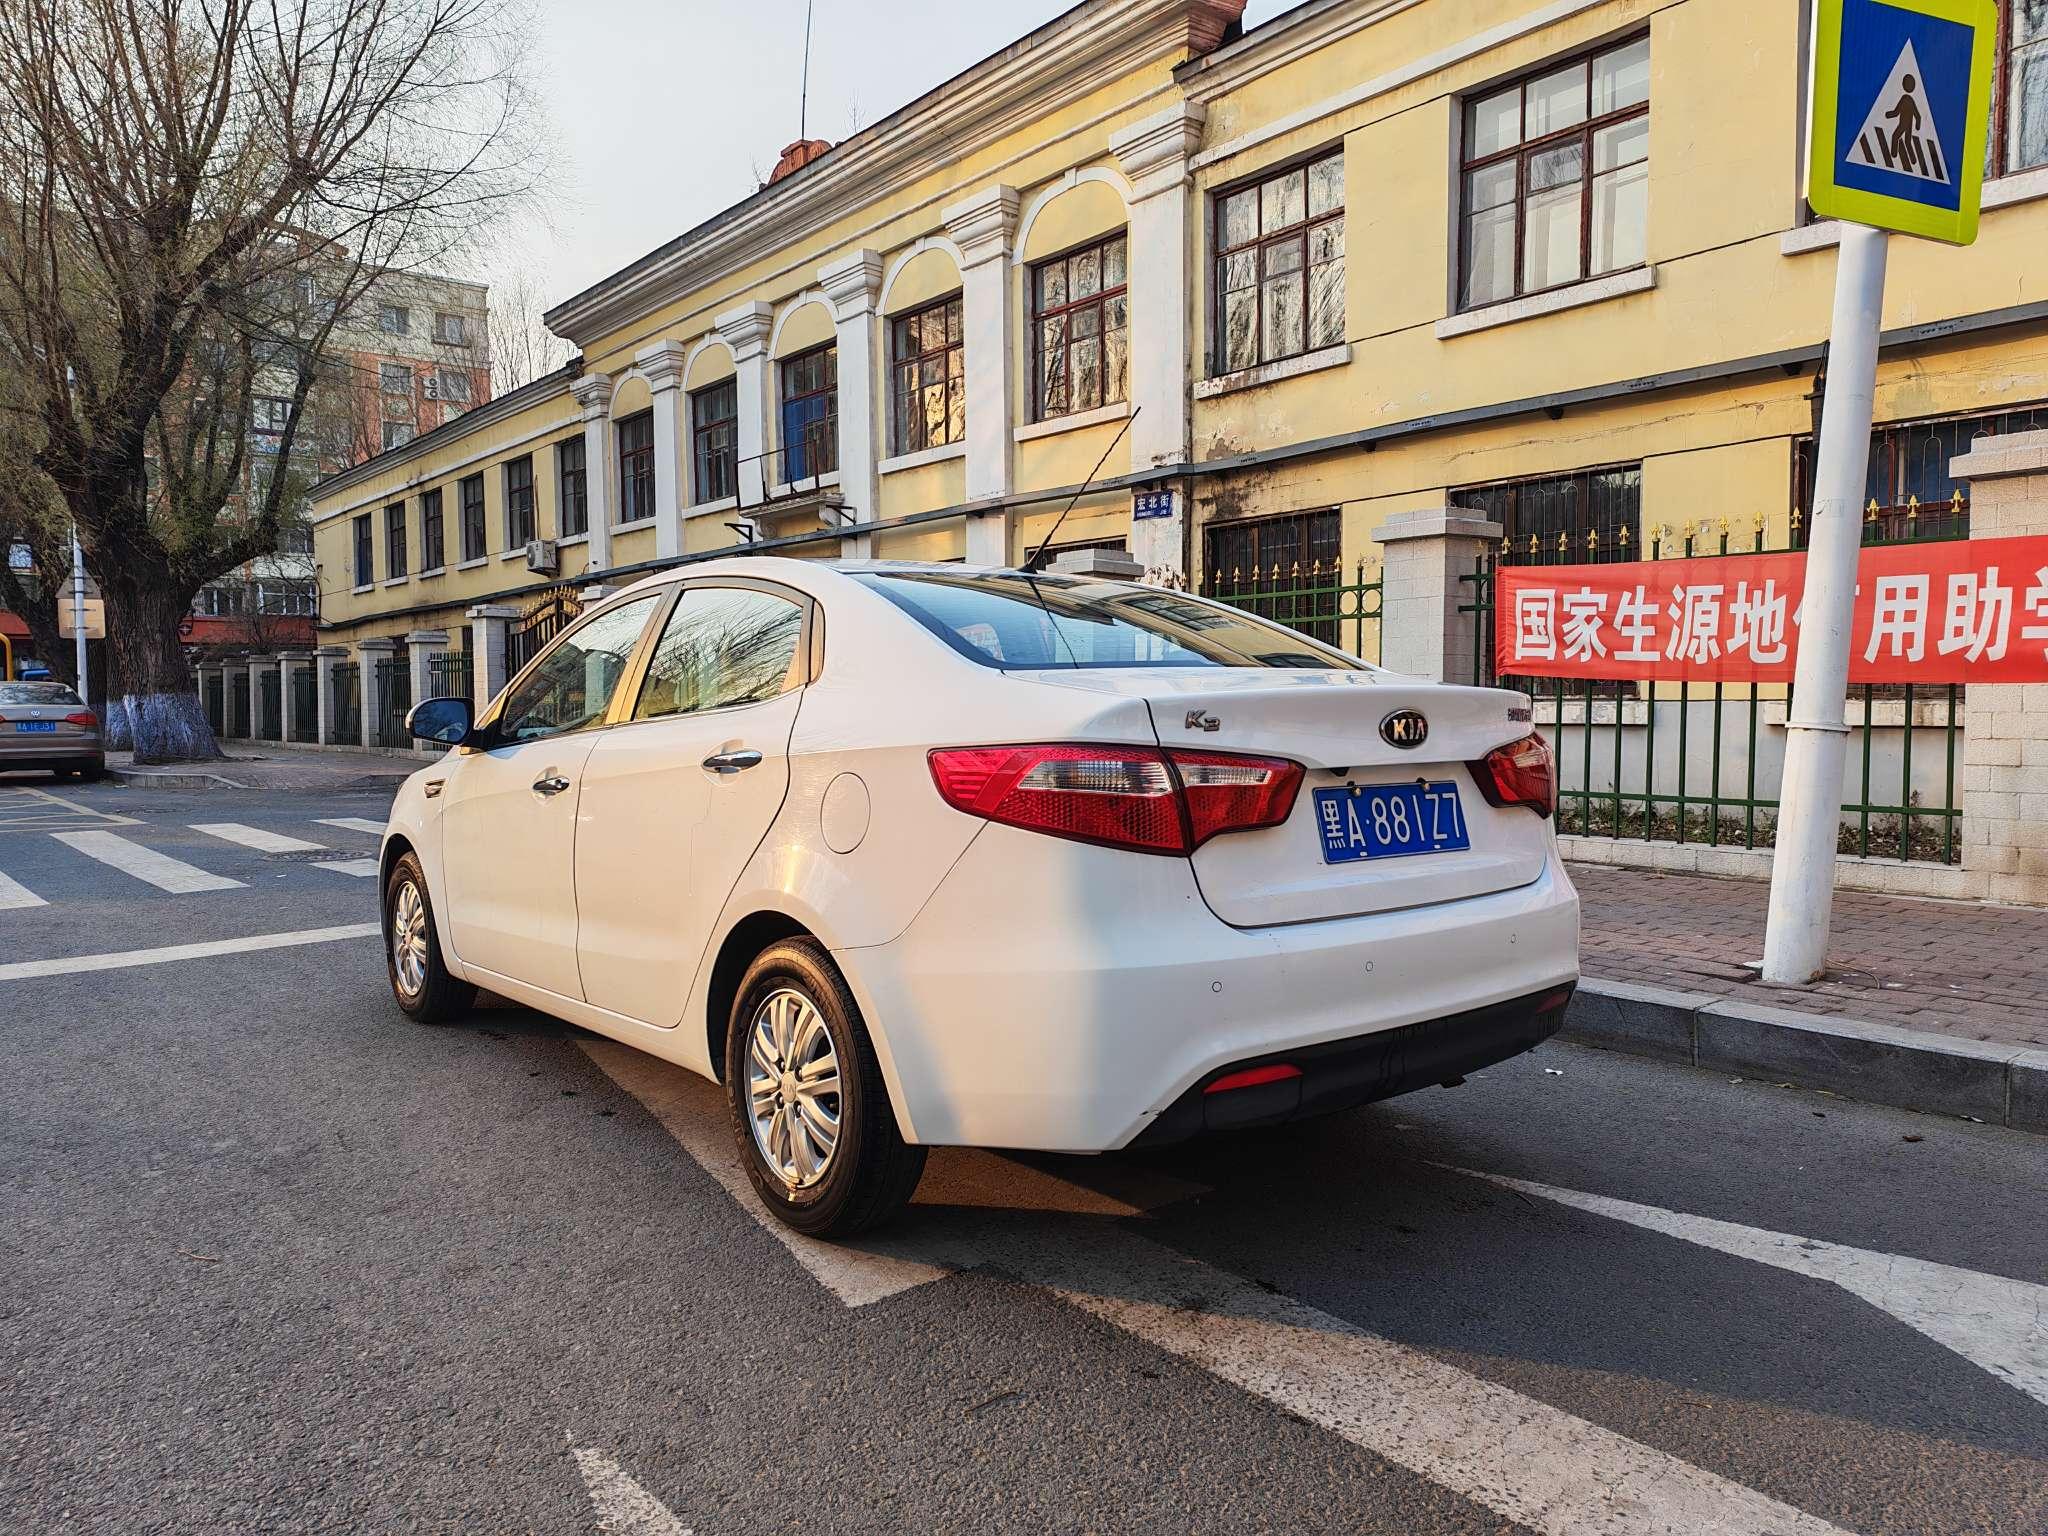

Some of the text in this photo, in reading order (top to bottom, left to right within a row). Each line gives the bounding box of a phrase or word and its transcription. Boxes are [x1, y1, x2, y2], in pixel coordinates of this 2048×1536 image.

[1514, 566, 2048, 664] 国家生源地用助
[1392, 718, 1425, 740] KIA
